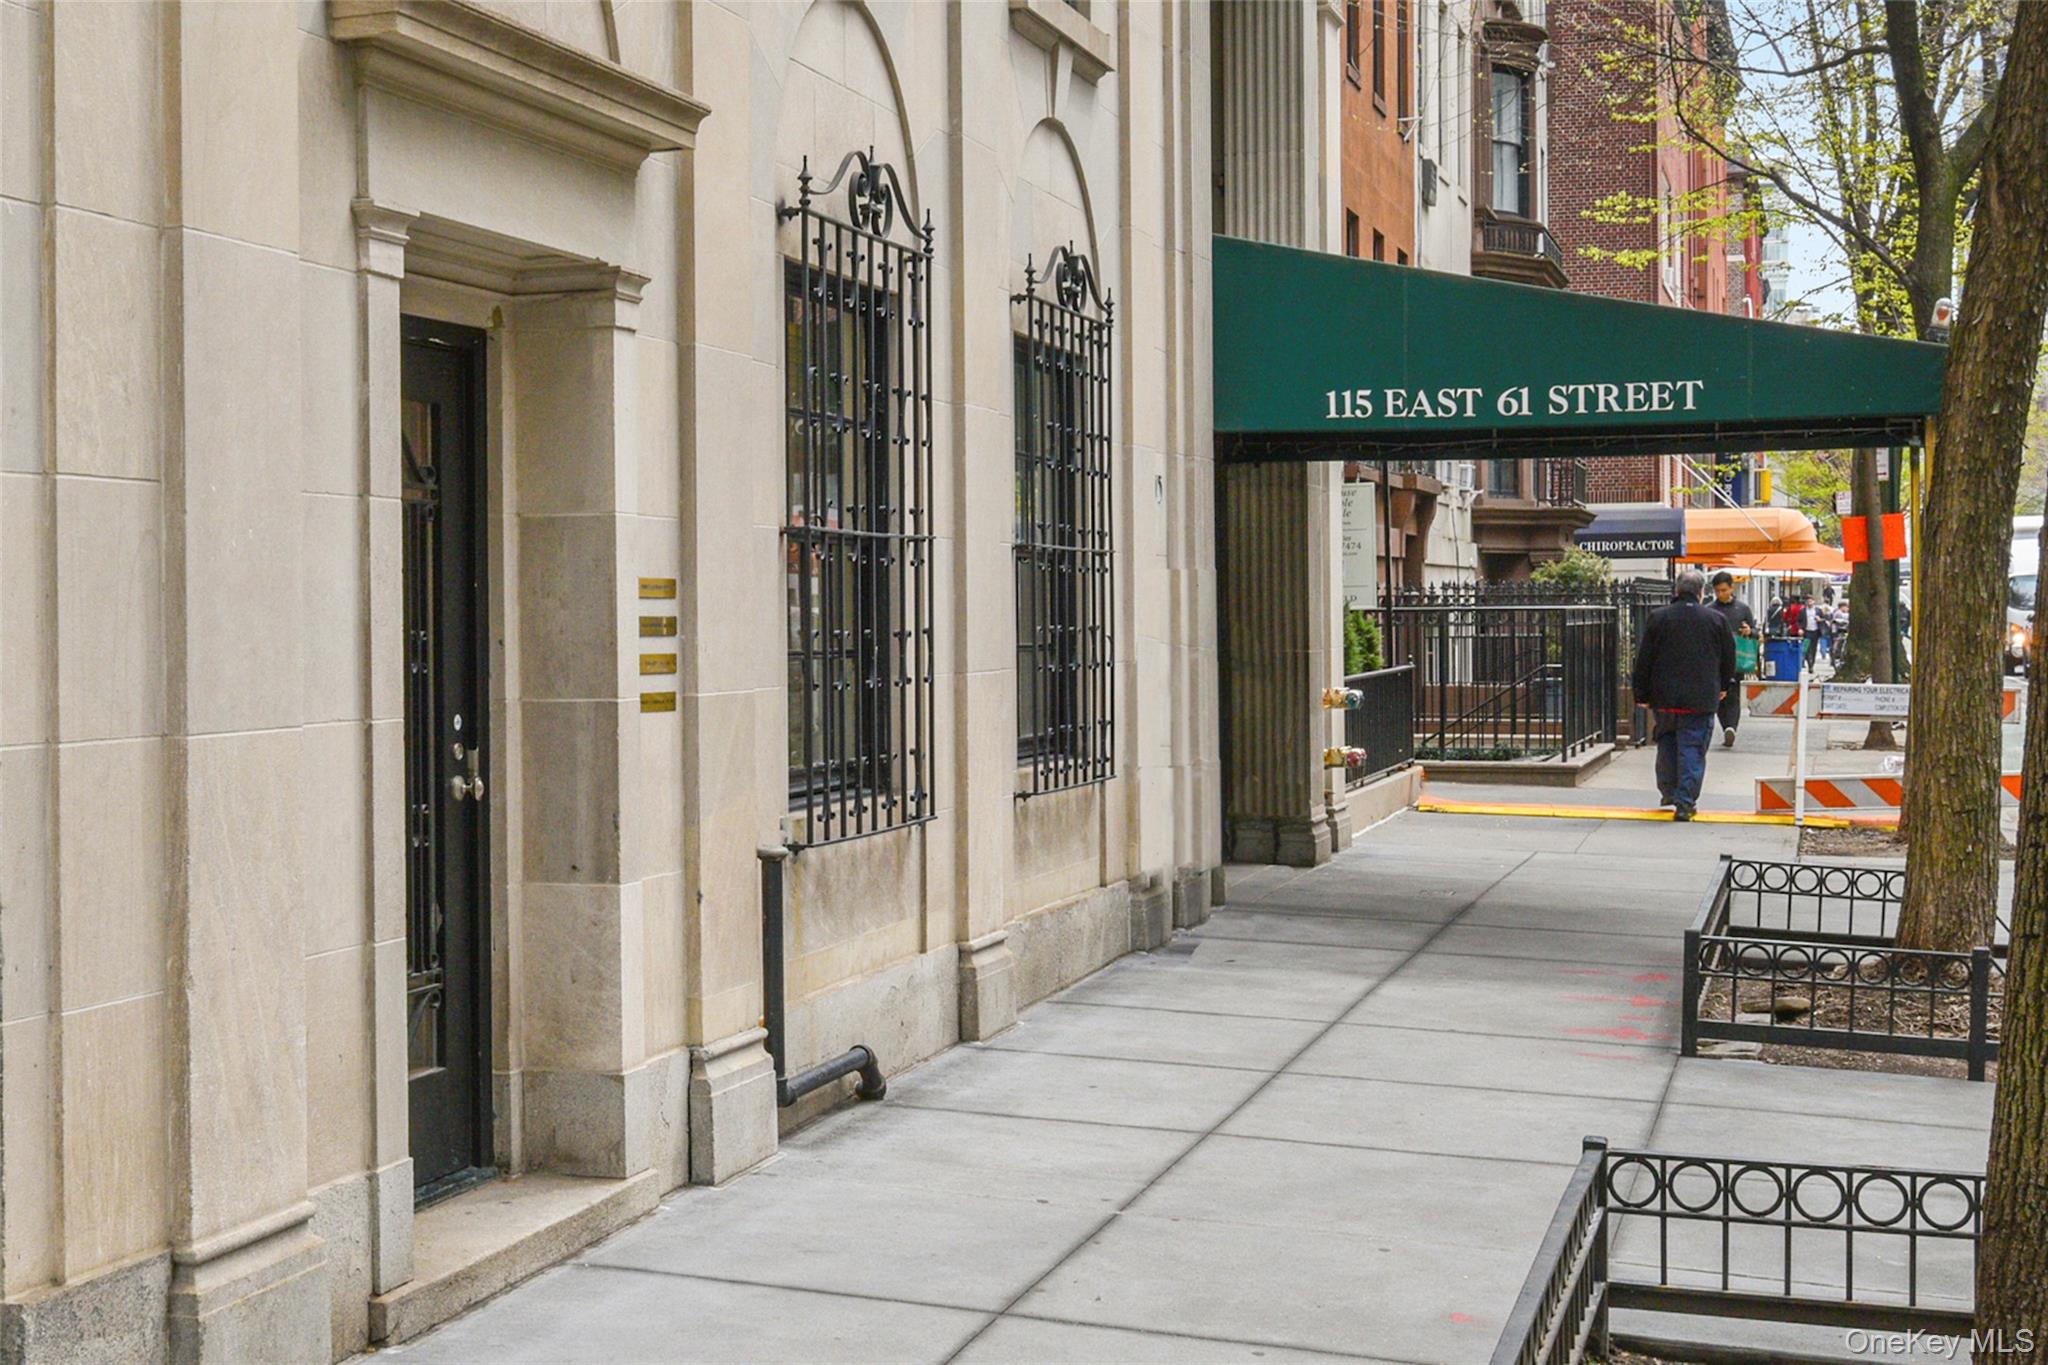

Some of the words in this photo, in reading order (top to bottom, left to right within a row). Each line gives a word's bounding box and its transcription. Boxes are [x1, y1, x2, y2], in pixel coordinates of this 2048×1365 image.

[1325, 389, 1373, 419] 115
[1384, 387, 1483, 418] EAST
[1497, 386, 1533, 416] 61
[1548, 380, 1704, 415] STREET
[1579, 539, 1675, 552] CHIROPRACTOR
[1862, 686, 1878, 694] YOUR
